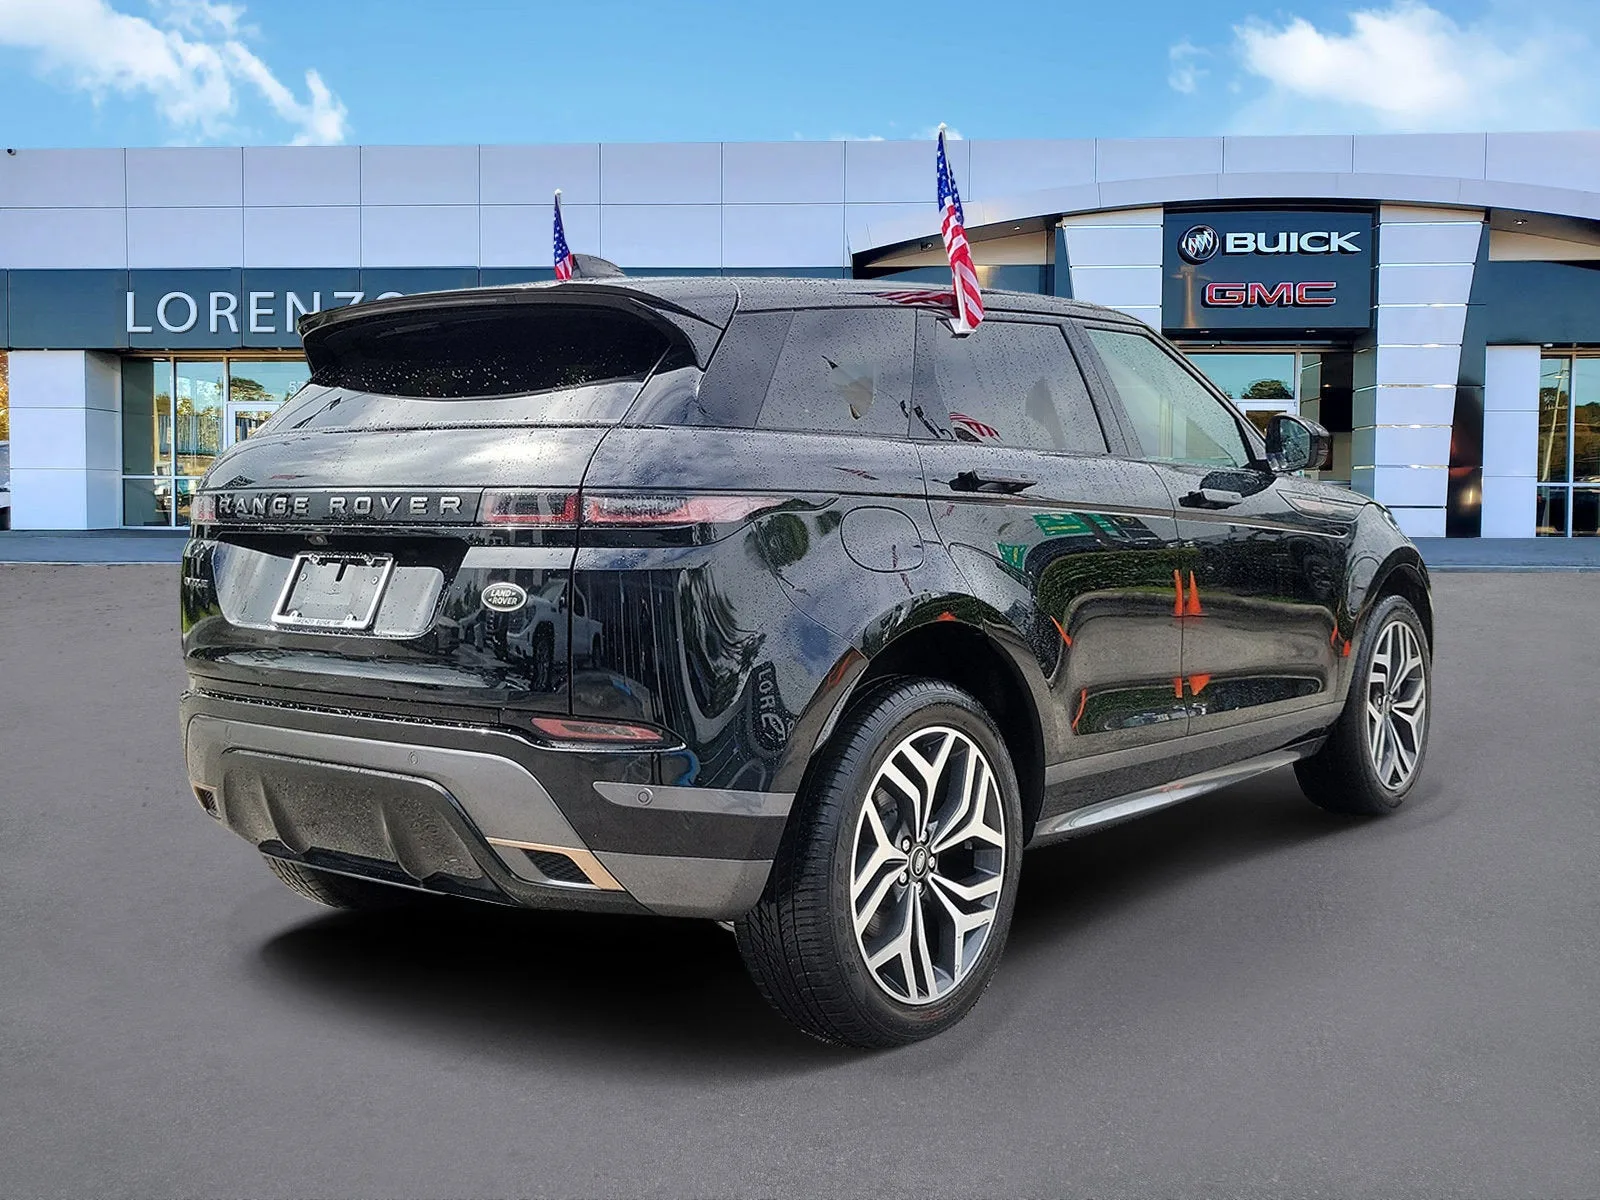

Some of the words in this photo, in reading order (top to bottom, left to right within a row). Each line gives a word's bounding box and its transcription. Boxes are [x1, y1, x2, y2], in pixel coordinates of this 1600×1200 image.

[1225, 231, 1362, 253] BUICK
[1205, 281, 1337, 305] GMC
[126, 291, 405, 333] LOREN
[218, 495, 310, 515] RANGE
[329, 496, 463, 515] ROVER
[490, 589, 512, 597] LAND
[492, 597, 518, 605] ROVER
